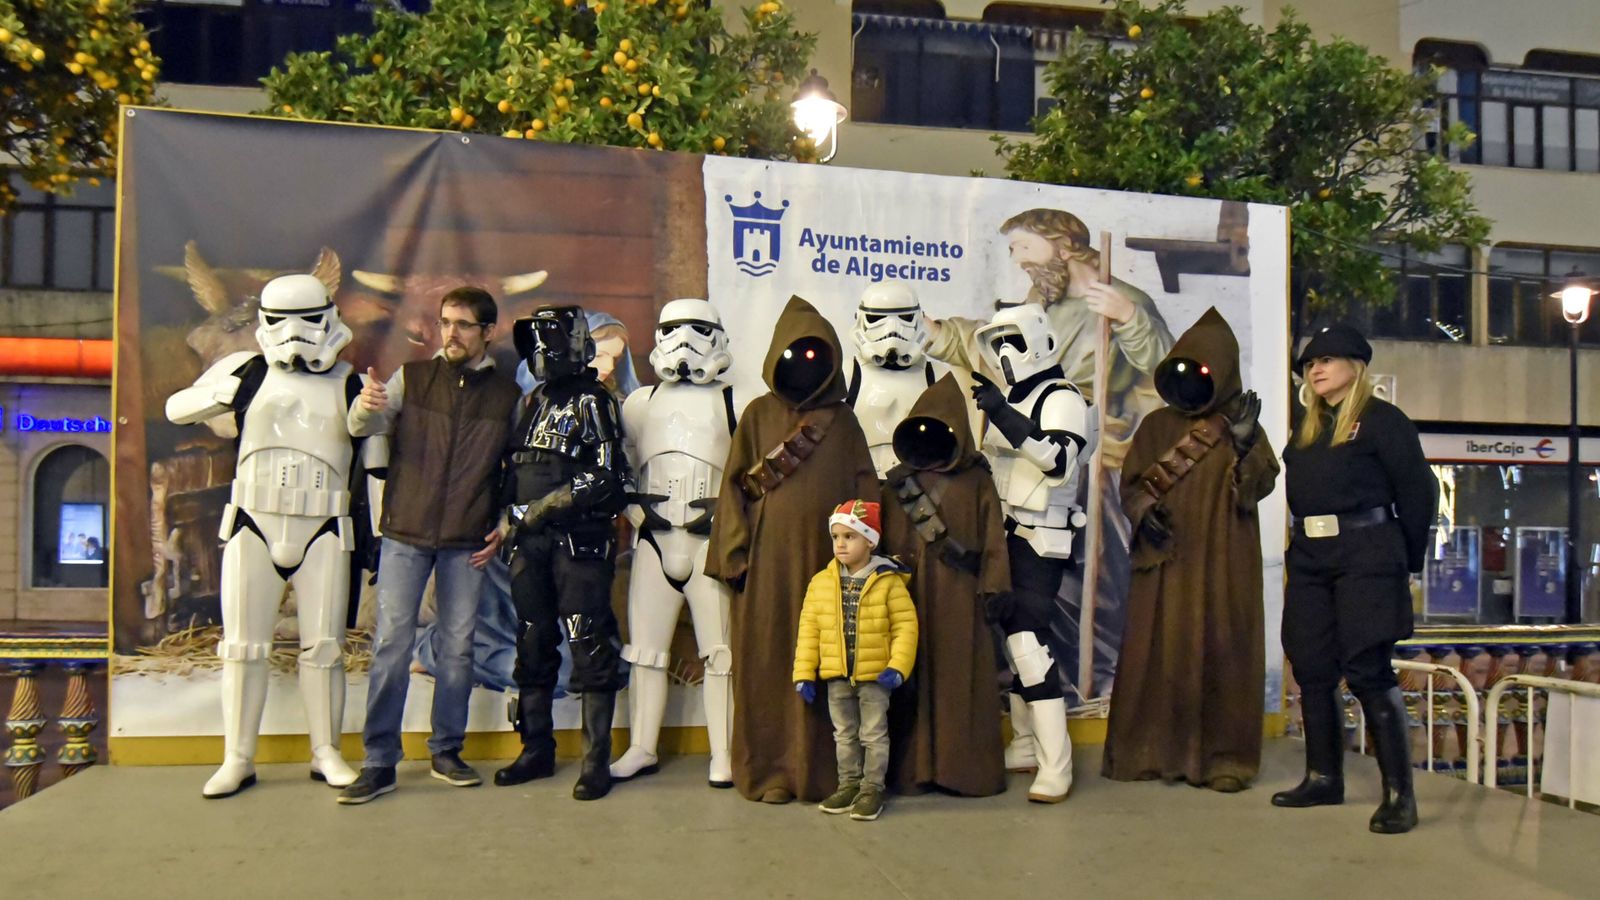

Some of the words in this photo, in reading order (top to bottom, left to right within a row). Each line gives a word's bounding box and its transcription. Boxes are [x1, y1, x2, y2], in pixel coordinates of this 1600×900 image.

[799, 228, 964, 259] Ayuntamiento
[811, 252, 841, 274] de
[845, 256, 951, 282] Algeciras
